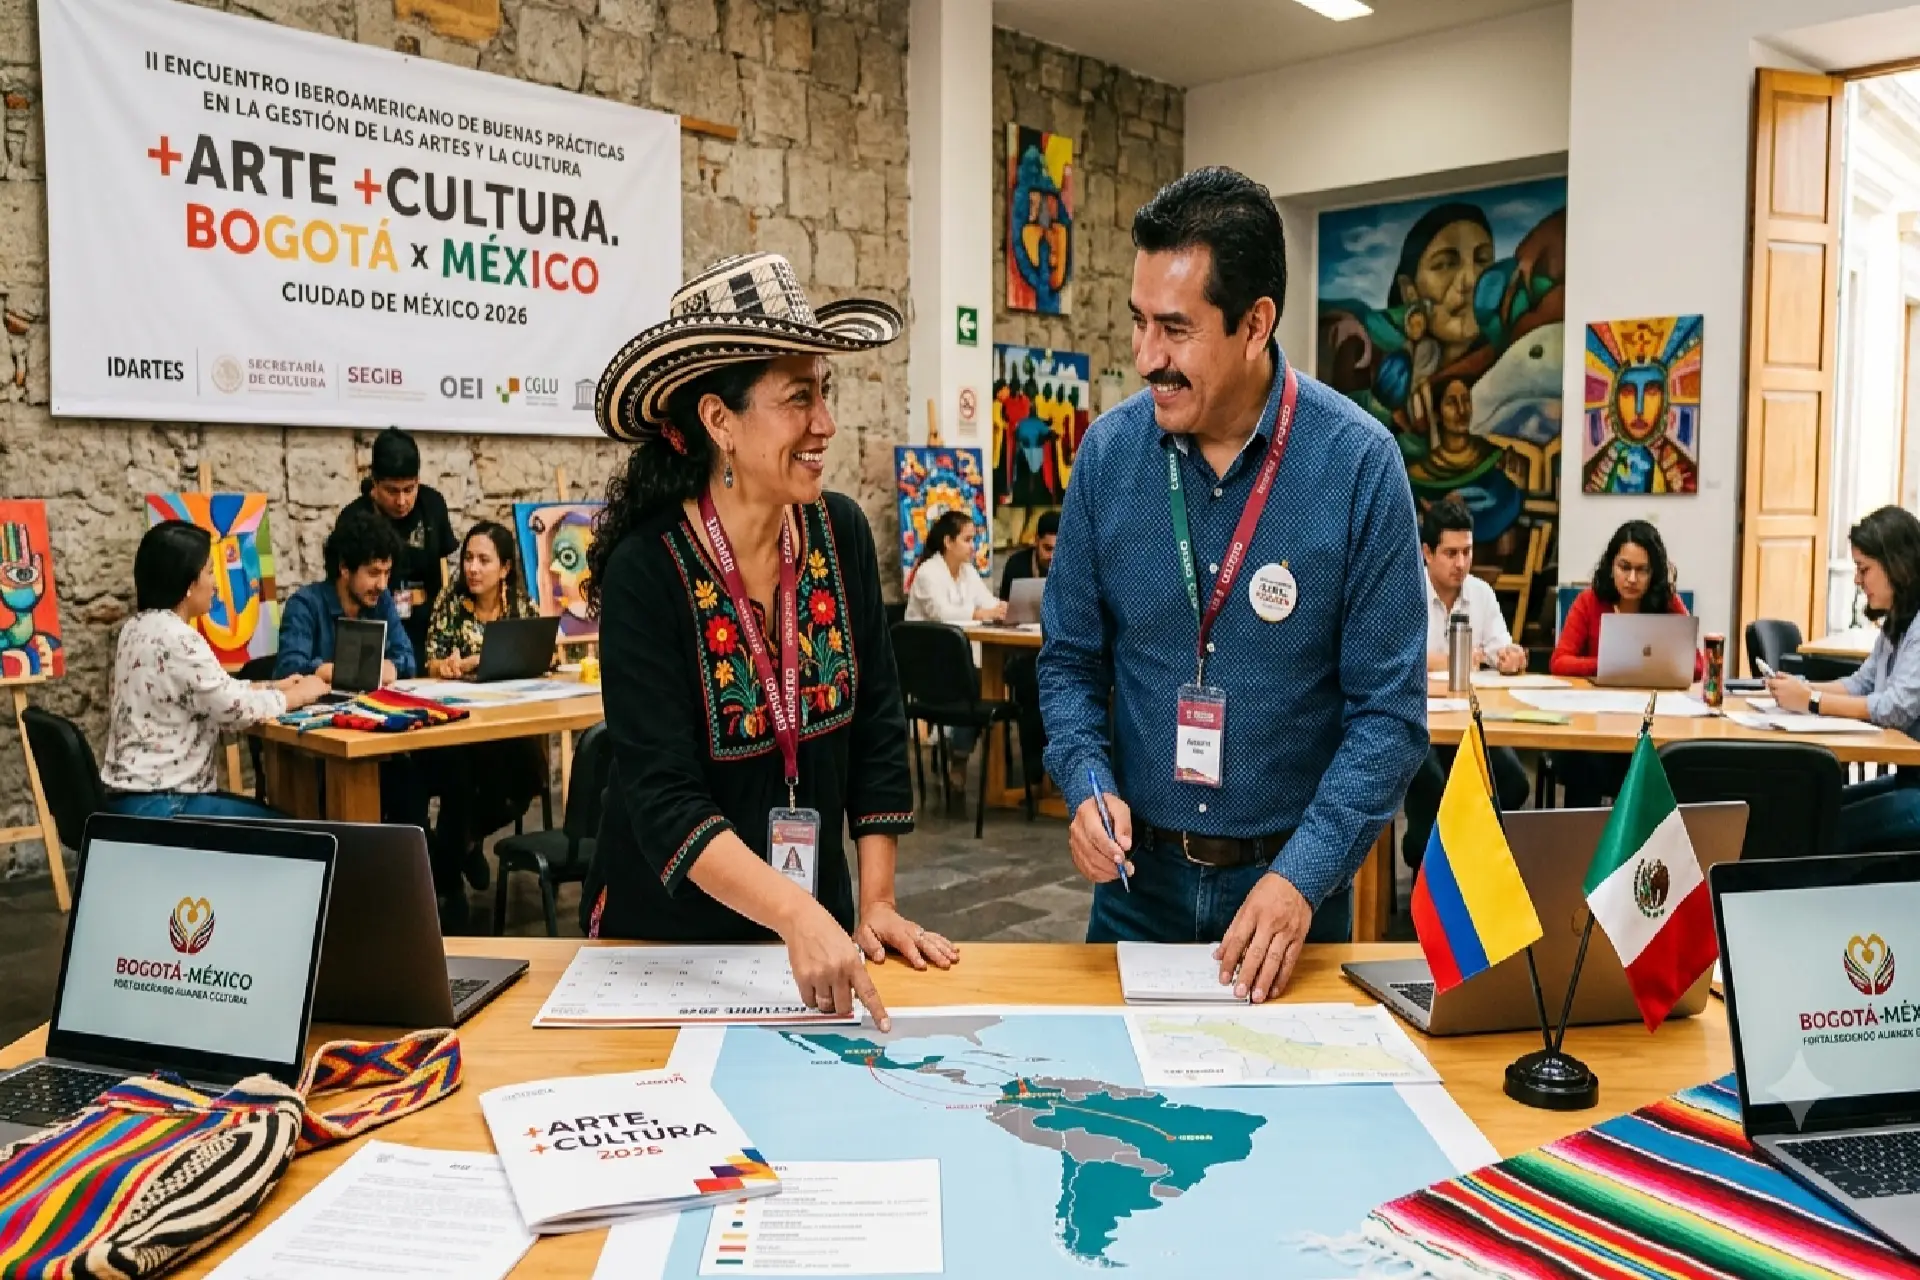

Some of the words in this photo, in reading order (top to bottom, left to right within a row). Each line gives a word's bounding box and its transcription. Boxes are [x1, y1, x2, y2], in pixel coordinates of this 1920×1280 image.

[146, 51, 158, 70] II
[164, 54, 289, 95] ENCUENTRO
[295, 81, 454, 127] IBEROAMERICANO
[458, 114, 479, 133] DE
[483, 120, 542, 146] BUENAS
[547, 132, 625, 161] PRÁCTICAS
[204, 90, 229, 114] EN
[236, 98, 260, 119] LA
[265, 103, 349, 134] GESTIÓN
[355, 121, 378, 140] DE
[383, 125, 414, 146] LAS
[418, 133, 470, 157] ARTES
[475, 141, 484, 159] Y
[489, 145, 507, 164] LA
[512, 151, 581, 177] CULTURA
[148, 133, 338, 206] +ARTE
[354, 167, 619, 247] +CULTURA.
[186, 203, 399, 272] BOGOTÁ
[442, 233, 599, 294] MÉXICO
[282, 281, 365, 308] CIUDAD
[371, 289, 397, 312] DE
[403, 292, 479, 320] MÉXICO
[484, 304, 528, 325] 2026
[107, 356, 184, 382] IDARTES
[248, 357, 325, 374] SECRETARÍA
[249, 374, 266, 385] DE
[348, 366, 402, 385] SEGIB
[440, 375, 483, 400] OEI
[524, 375, 559, 395] CGLU
[116, 958, 253, 990] BOGOTÁ-MÉXICO
